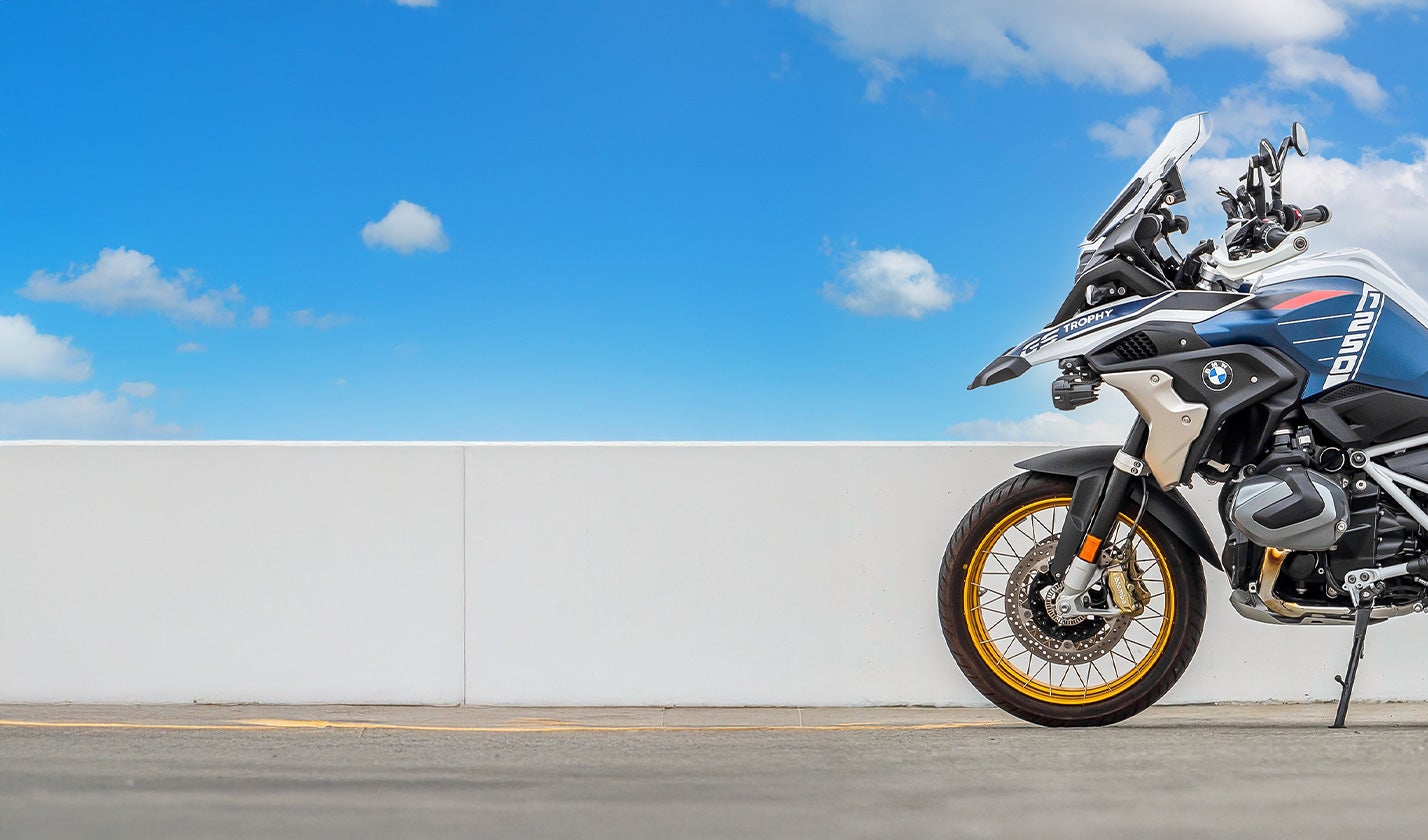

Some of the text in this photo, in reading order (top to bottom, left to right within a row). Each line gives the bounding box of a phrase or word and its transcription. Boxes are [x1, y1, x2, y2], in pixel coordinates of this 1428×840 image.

[1063, 308, 1114, 333] TROPHY
[1020, 328, 1059, 356] GS
[1204, 361, 1227, 375] BMW
